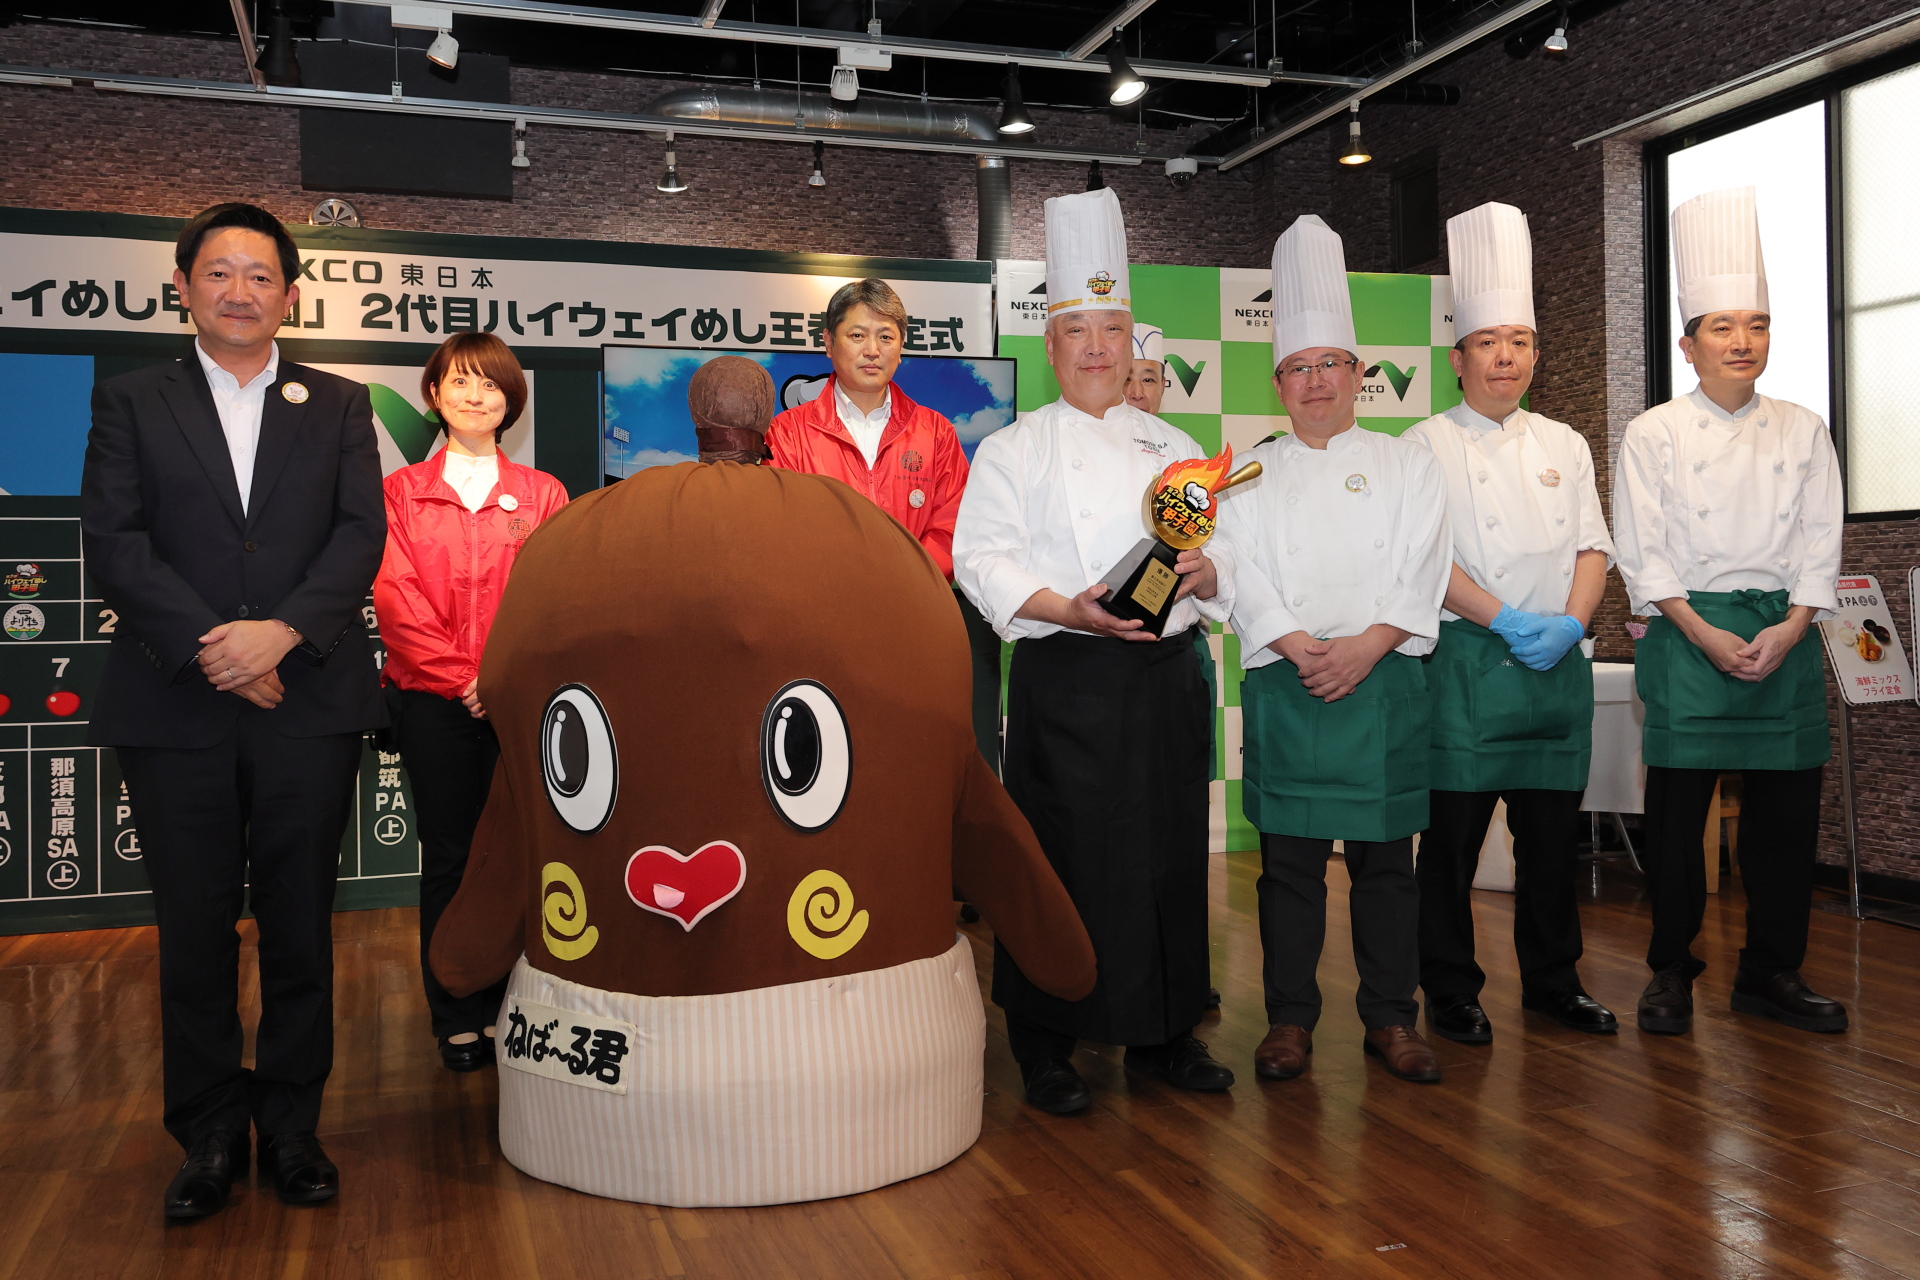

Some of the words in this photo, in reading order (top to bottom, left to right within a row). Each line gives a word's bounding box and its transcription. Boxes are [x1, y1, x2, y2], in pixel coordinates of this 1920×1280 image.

[299, 258, 383, 284] XCO
[401, 263, 493, 289] 東日本
[1011, 301, 1048, 311] NEXC
[1361, 385, 1385, 393] XCO
[1158, 492, 1214, 531] ハイウェイめし
[10, 615, 39, 627] よりみち
[98, 609, 119, 633] 2
[374, 651, 388, 669] 1
[51, 658, 70, 678] 7
[1855, 675, 1902, 686] 海鮮ミックス
[1863, 685, 1902, 697] フライ定食
